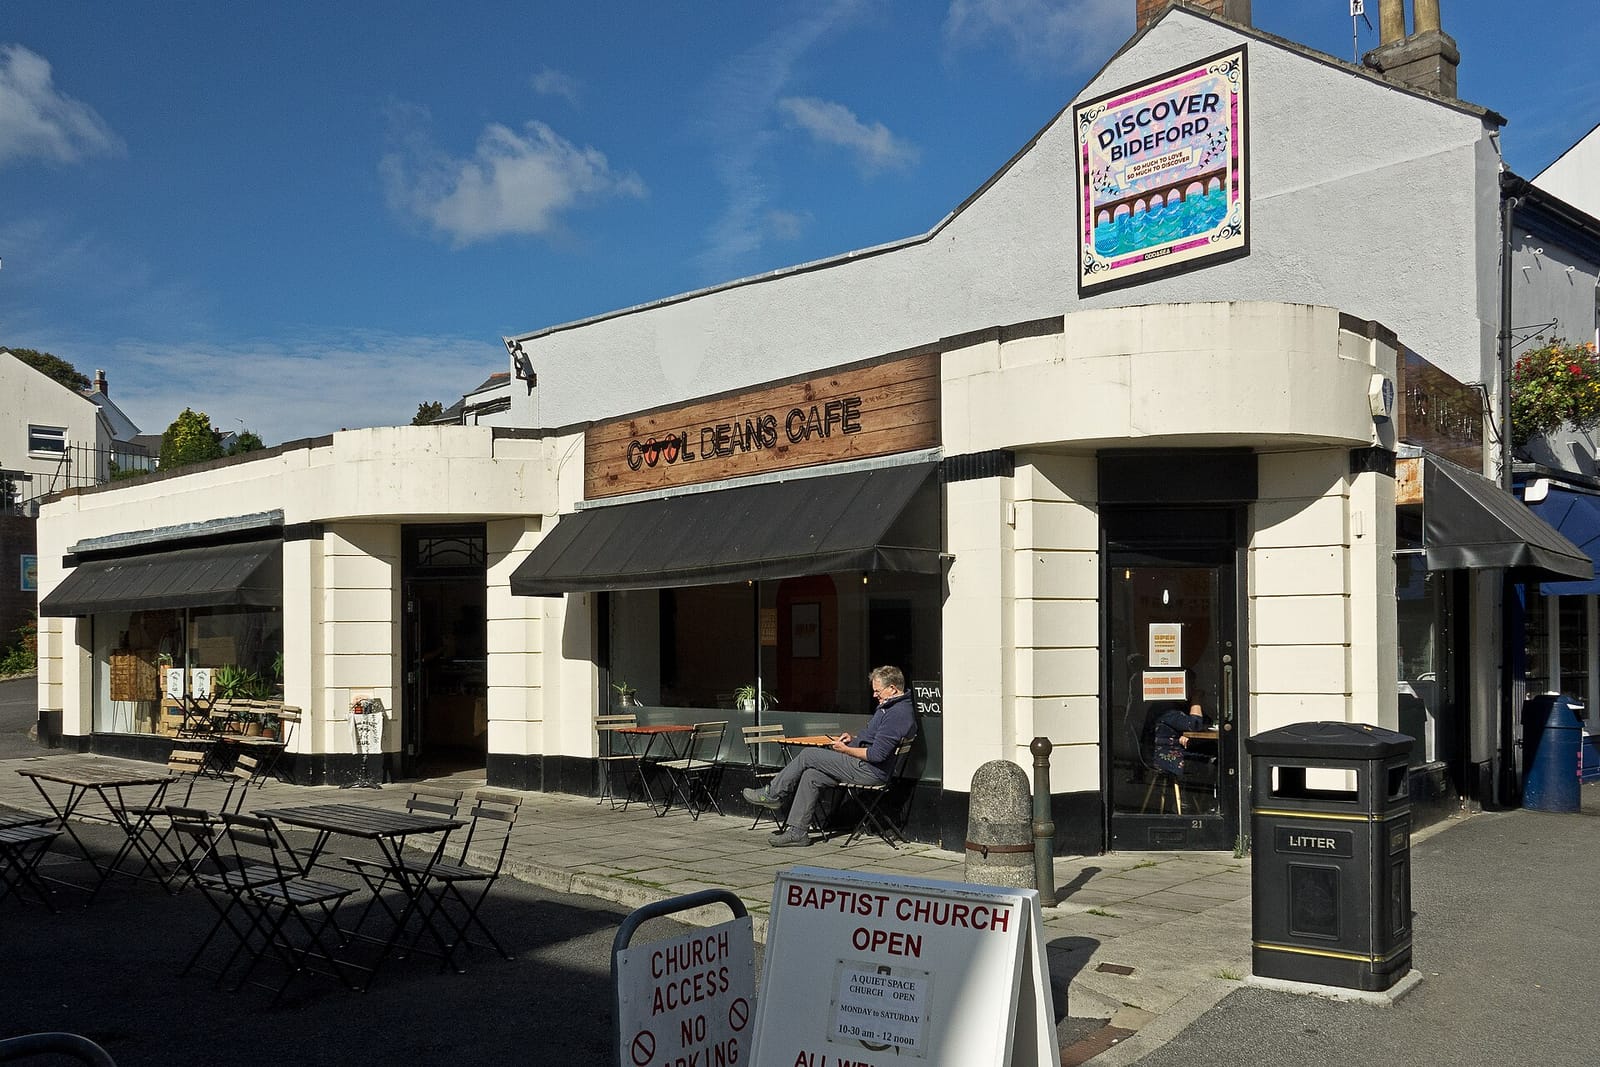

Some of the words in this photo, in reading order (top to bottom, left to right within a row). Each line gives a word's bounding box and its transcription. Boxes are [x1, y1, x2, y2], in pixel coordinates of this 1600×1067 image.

[1098, 93, 1219, 149] DISCOVER
[1111, 117, 1209, 162] BIDEFORD
[1135, 168, 1151, 177] MUCH
[1161, 155, 1190, 169] DISCOVER
[1142, 160, 1158, 168] MUCH
[1168, 152, 1182, 161] LOVE
[626, 432, 695, 471] COOL
[700, 414, 778, 460] BEANS
[785, 397, 862, 445] CAFE
[1191, 820, 1203, 829] 21
[1289, 835, 1336, 849] LITTER
[787, 885, 890, 919] BAPTIST
[895, 897, 1010, 933] CHURCH
[651, 931, 729, 979] CHURCH
[851, 927, 923, 959] OPEN
[652, 966, 729, 1016] ACCESS
[849, 985, 884, 997] CHURCH
[892, 991, 916, 1002] OPEN
[851, 974, 858, 983] A
[859, 975, 887, 987] QUIET
[887, 979, 916, 991] SPACE
[840, 1004, 873, 1016] MONDAY
[872, 1009, 880, 1017] to
[880, 1010, 920, 1024] SATURDAY
[681, 1014, 706, 1049] NO
[838, 1024, 860, 1036] 10-30
[861, 1030, 875, 1039] am
[882, 1031, 892, 1042] 12
[893, 1035, 915, 1046] noon
